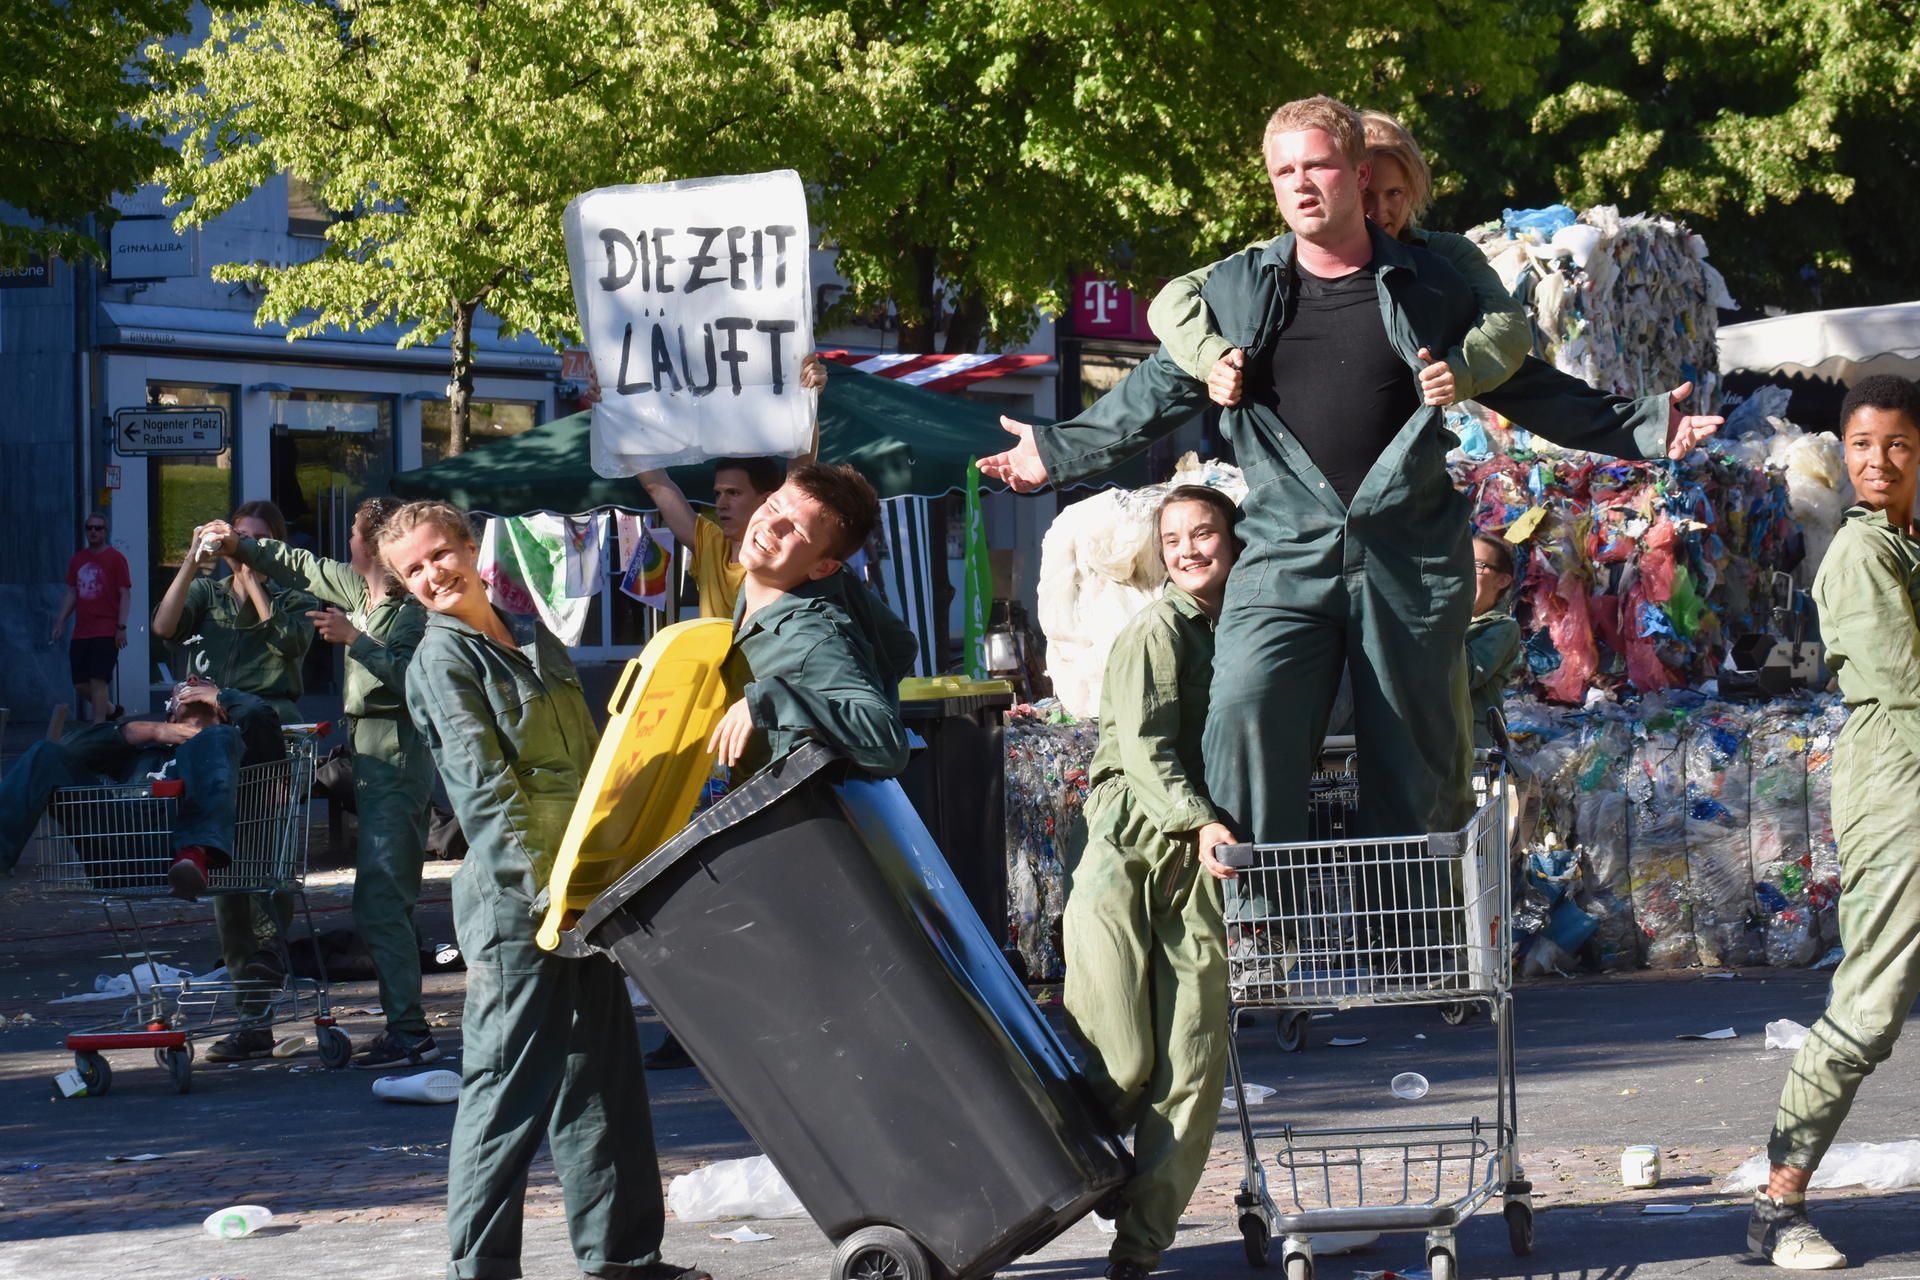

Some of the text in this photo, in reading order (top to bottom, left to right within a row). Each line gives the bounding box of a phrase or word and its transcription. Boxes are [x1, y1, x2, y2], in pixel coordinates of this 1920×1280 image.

[118, 242, 183, 254] GINALAURA
[598, 225, 796, 294] DIE ZEIT
[1085, 281, 1117, 323] T
[617, 308, 796, 397] LÄUFT
[143, 418, 217, 431] Nogenter Platz
[143, 434, 184, 444] Rathaus
